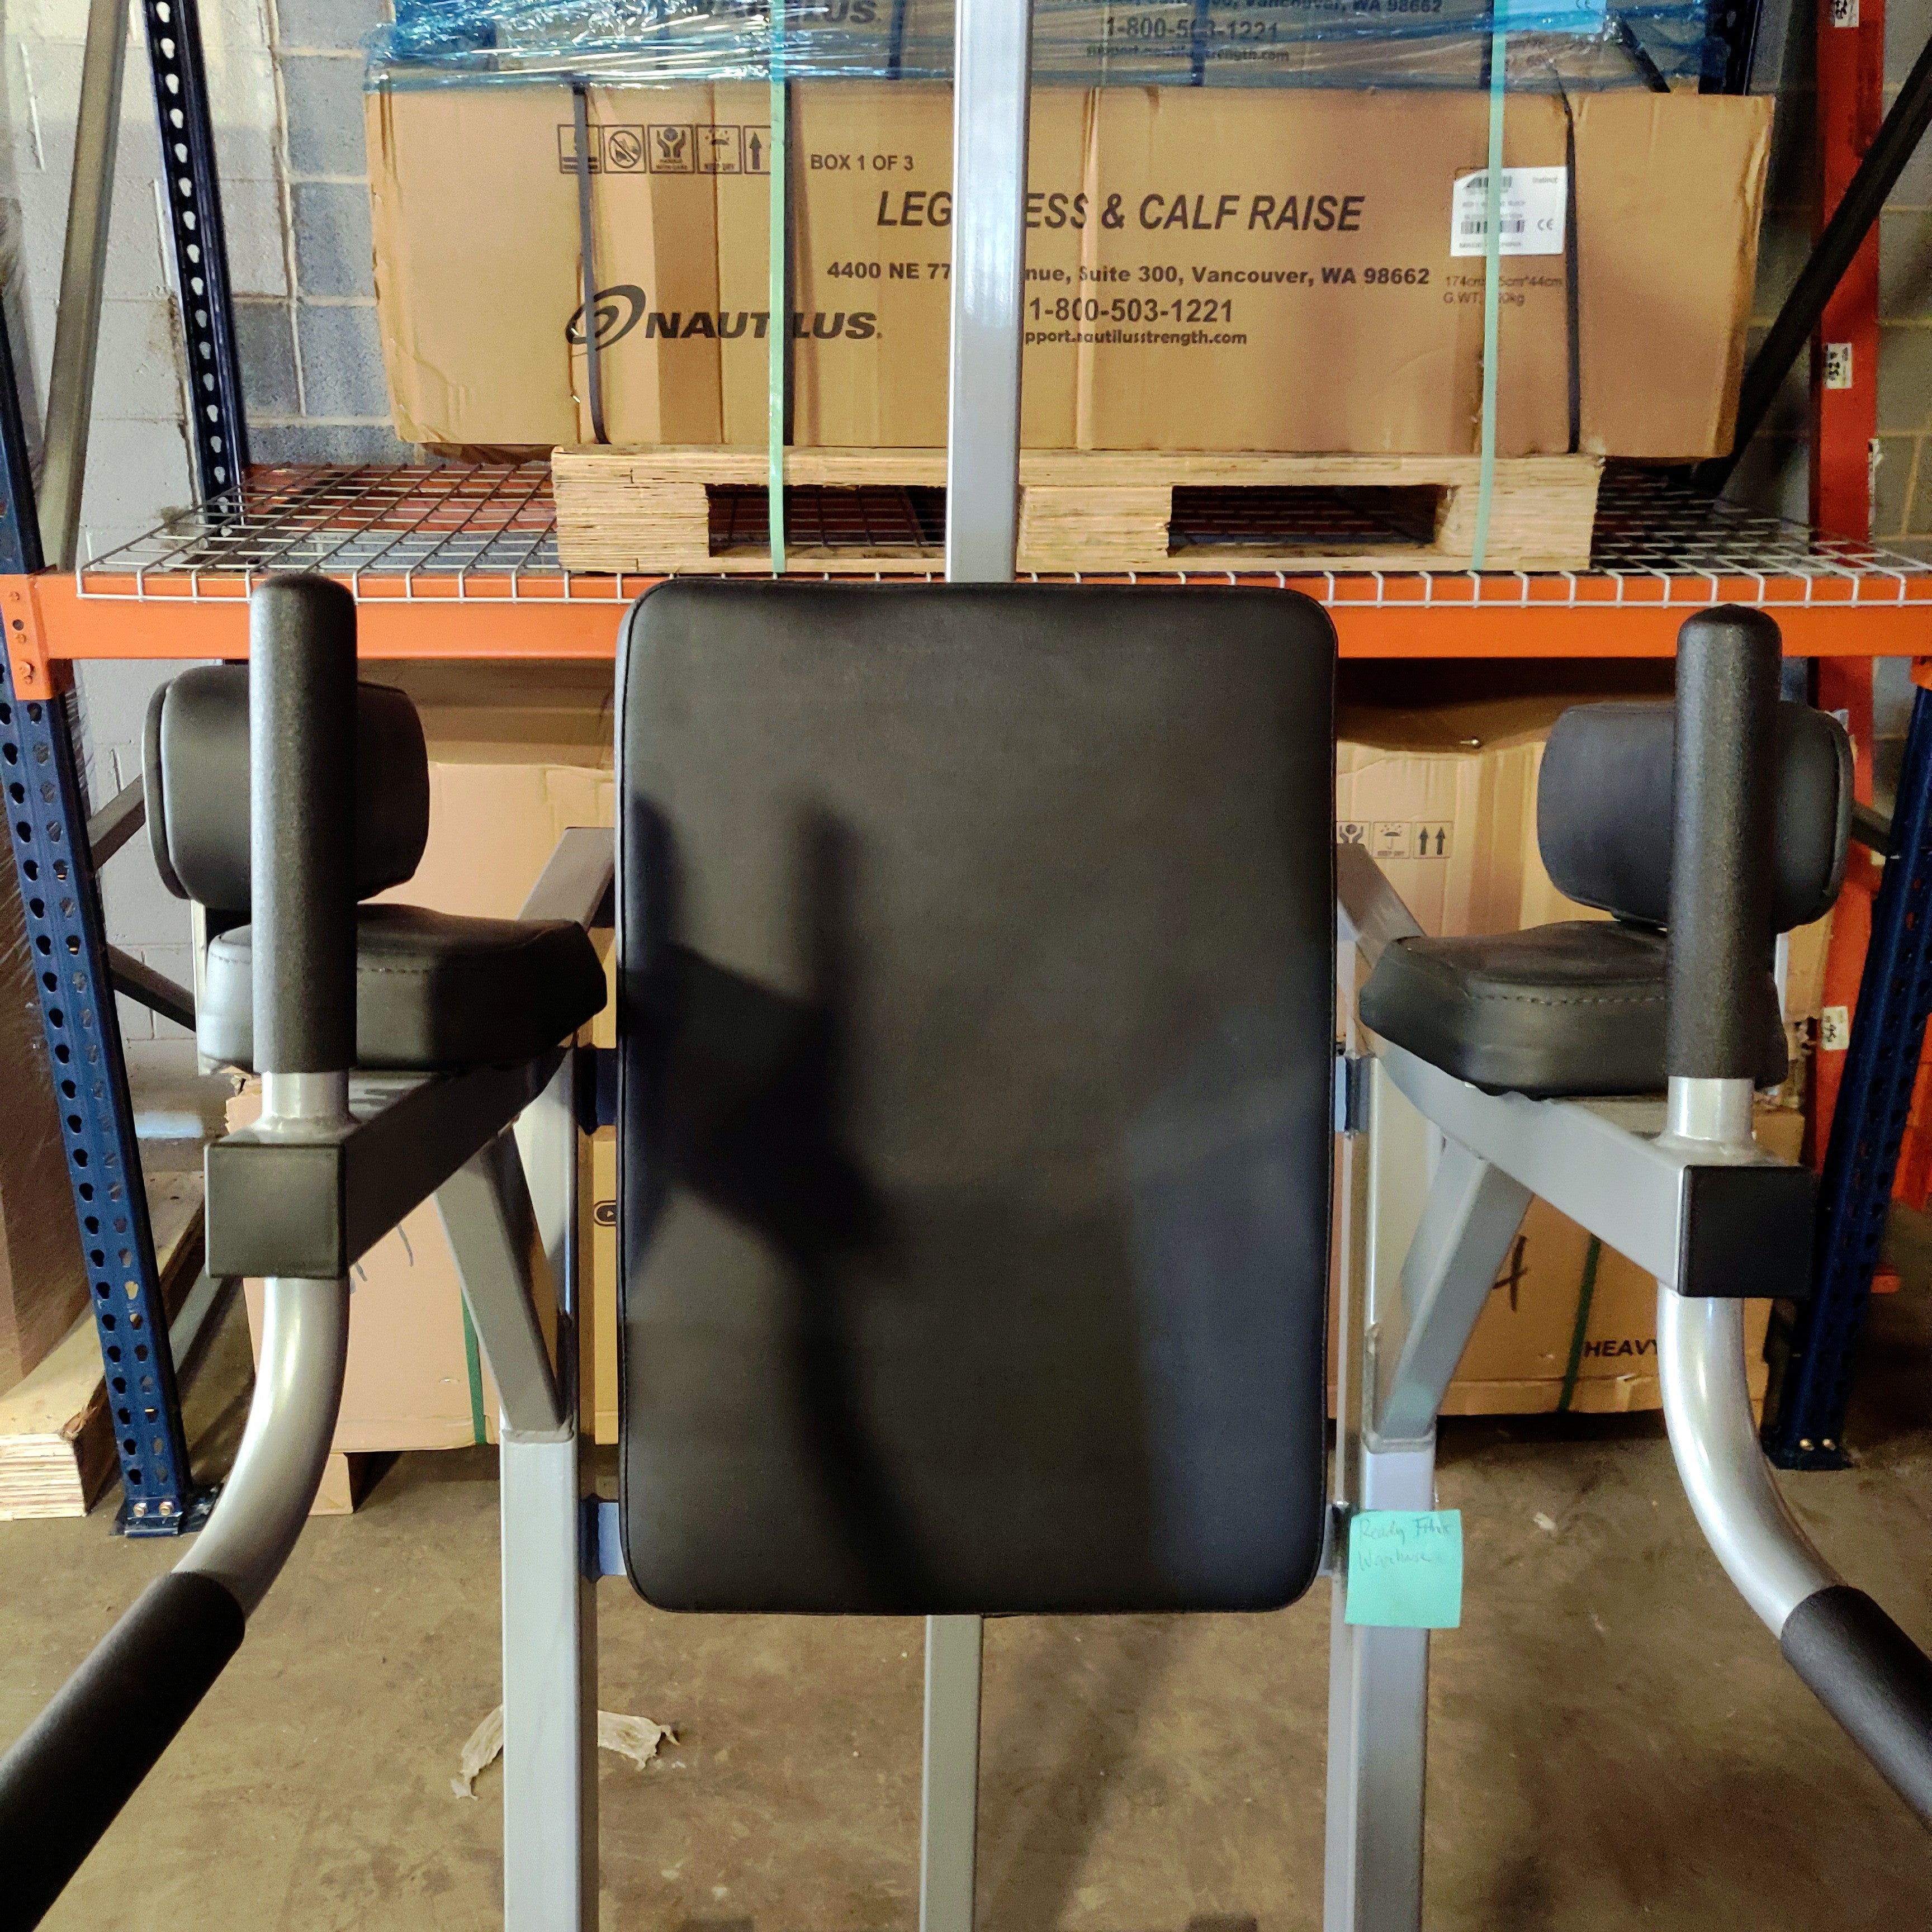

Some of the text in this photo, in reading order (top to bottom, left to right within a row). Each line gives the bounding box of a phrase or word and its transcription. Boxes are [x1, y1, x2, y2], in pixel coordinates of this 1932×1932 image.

[1106, 16, 1278, 39] 1-800-53-1221
[811, 154, 913, 171] BOX 1 OF 3
[877, 191, 1365, 231] LEG ESS & CALF RAISE
[827, 262, 1430, 287] 4400 NE 77 nue, Suite 300, Vancouver, WA 98662
[1029, 297, 1233, 323] 1-800-503-1221
[1025, 330, 1247, 346] pport.nautilusstrength.com
